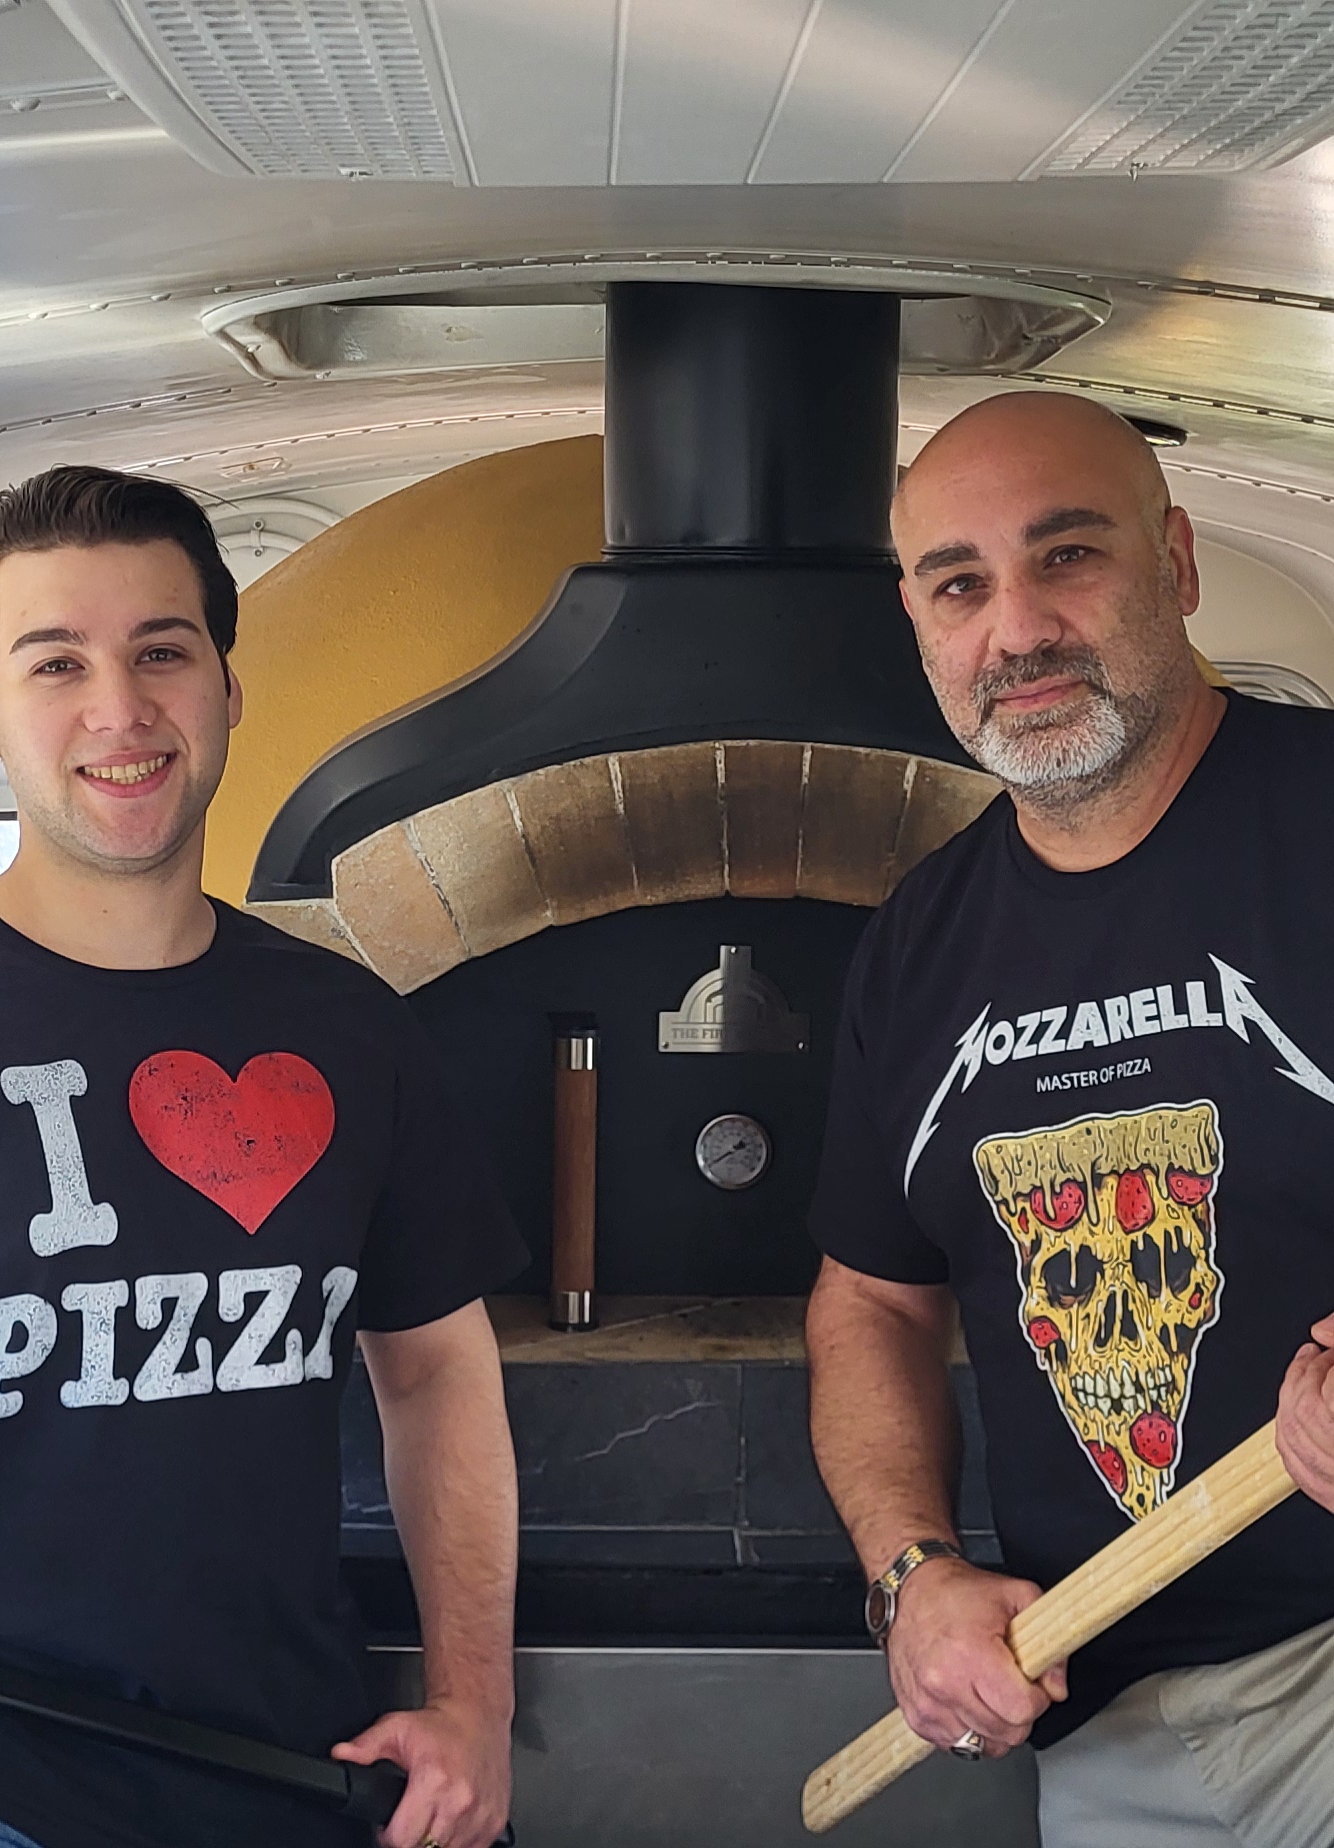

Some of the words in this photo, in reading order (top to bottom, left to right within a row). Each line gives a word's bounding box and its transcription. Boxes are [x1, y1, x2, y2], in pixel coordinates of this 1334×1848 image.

[672, 1028, 699, 1039] THE
[1036, 1070, 1098, 1093] MASTER
[1100, 1065, 1115, 1083] OF
[1117, 1057, 1152, 1079] PIZZA
[0, 1059, 119, 1257] I
